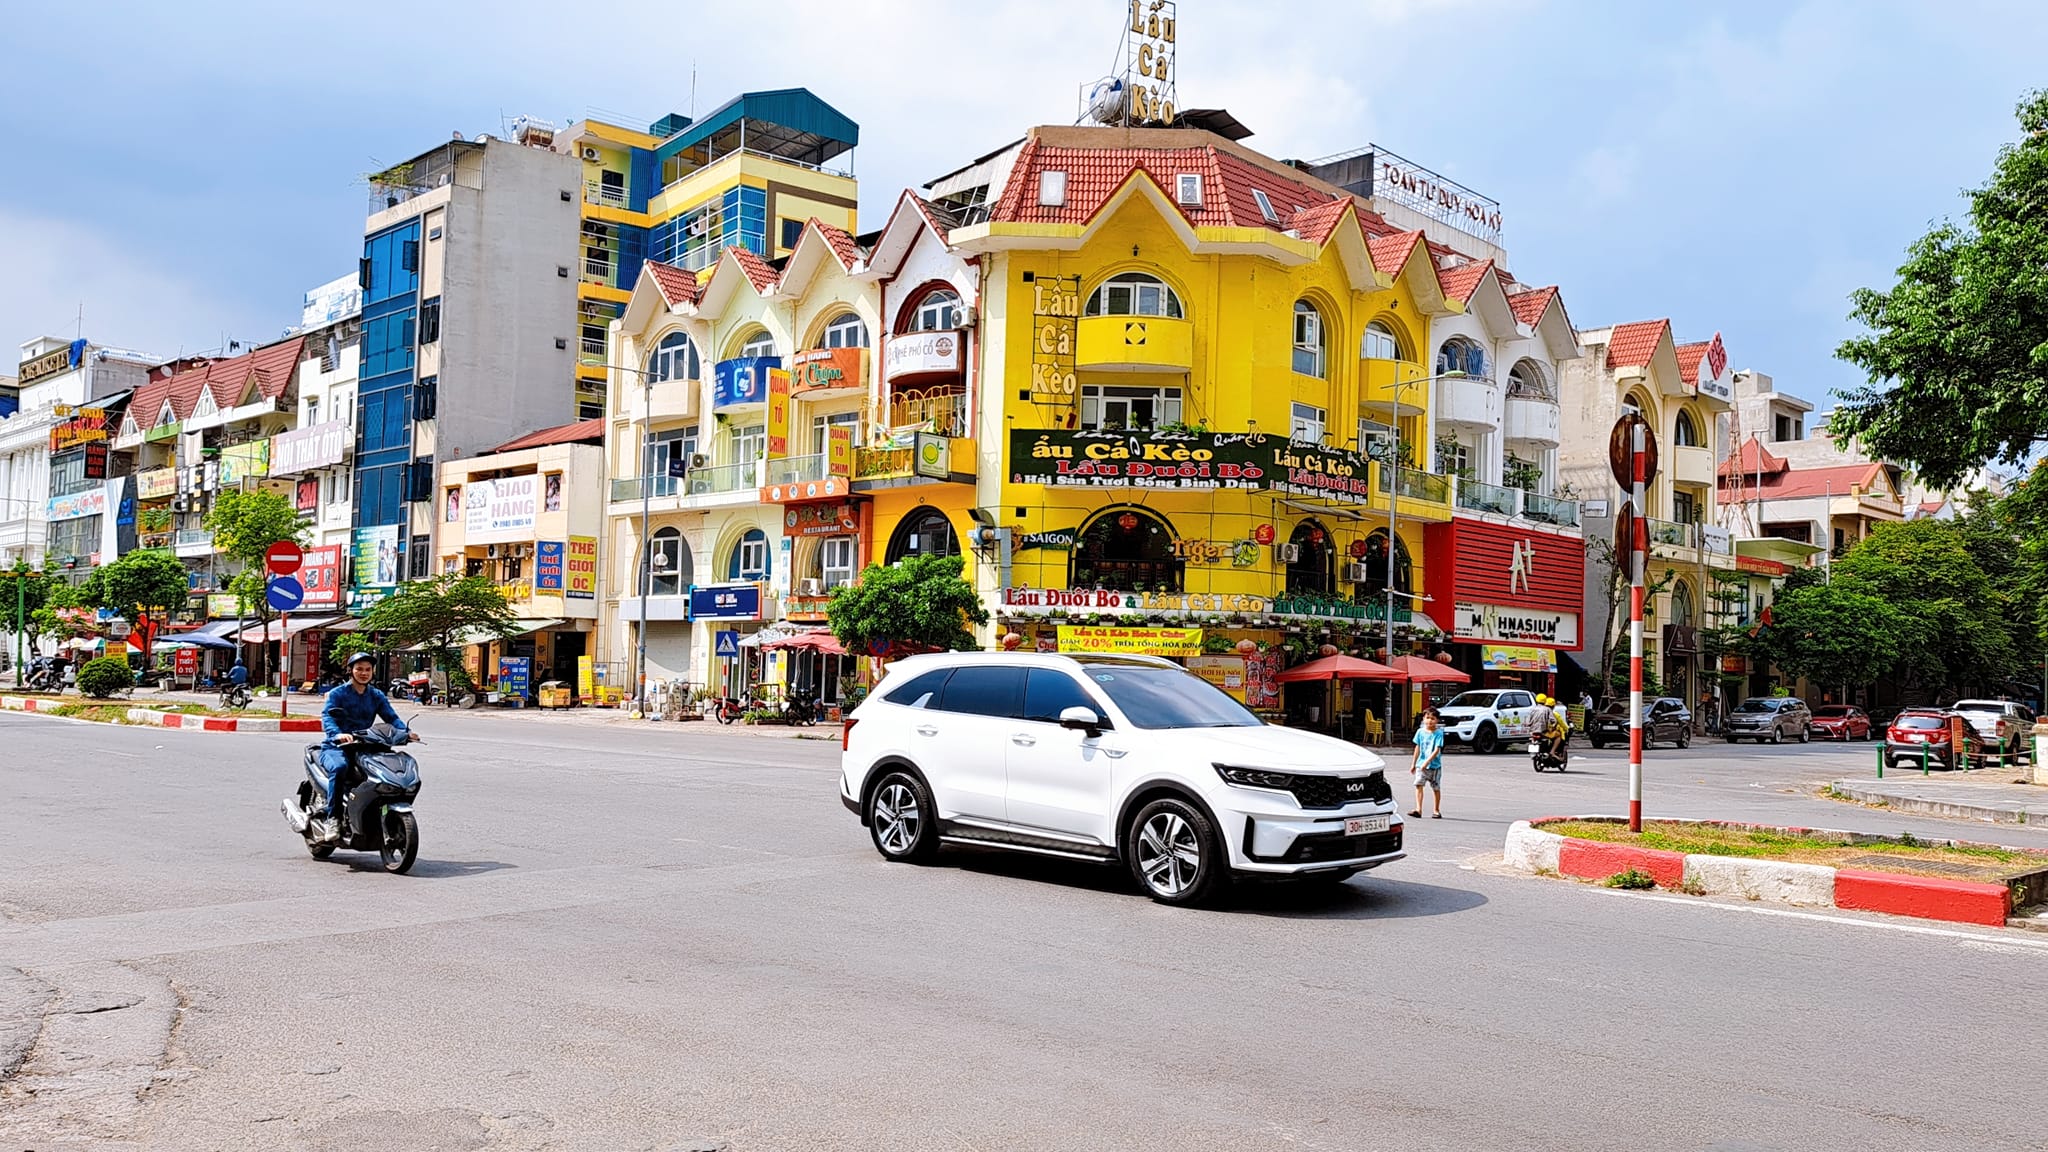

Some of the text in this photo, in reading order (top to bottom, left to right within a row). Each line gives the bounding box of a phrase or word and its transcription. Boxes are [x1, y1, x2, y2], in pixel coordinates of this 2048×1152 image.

[1131, 0, 1175, 43] Lẩu
[1138, 44, 1168, 81] Cá
[1131, 83, 1174, 126] Kèo
[1439, 188, 1461, 213] DUY
[1465, 202, 1486, 226] HOA
[1033, 274, 1078, 317] Lẩu
[1040, 324, 1070, 355] Cá
[1031, 362, 1076, 396] Kèo
[769, 435, 785, 454] CHIM
[1085, 441, 1130, 460] Cá
[1142, 443, 1213, 462] Kèo
[830, 463, 848, 474] CHIM
[1056, 460, 1264, 478] Lẩu Đuôi Bò
[1274, 446, 1353, 477] Lẩu Cá Kèo
[495, 480, 532, 498] GIAO
[1024, 473, 1053, 485] Hải
[1056, 474, 1087, 486] Sản
[1090, 476, 1129, 487] Tươi
[1134, 474, 1176, 489] Sống
[1225, 477, 1260, 490] Dân
[1350, 478, 1368, 494] Bò
[297, 482, 317, 509] 3M
[491, 499, 534, 518] HÀNG
[1029, 533, 1074, 545] SAIGON
[1171, 537, 1227, 566] Tiger
[1006, 583, 1264, 612] Lẩu Đuôi Bò & Lẩu Cá Kèo
[1083, 638, 1112, 648] 20%
[1346, 783, 1364, 792] KIA
